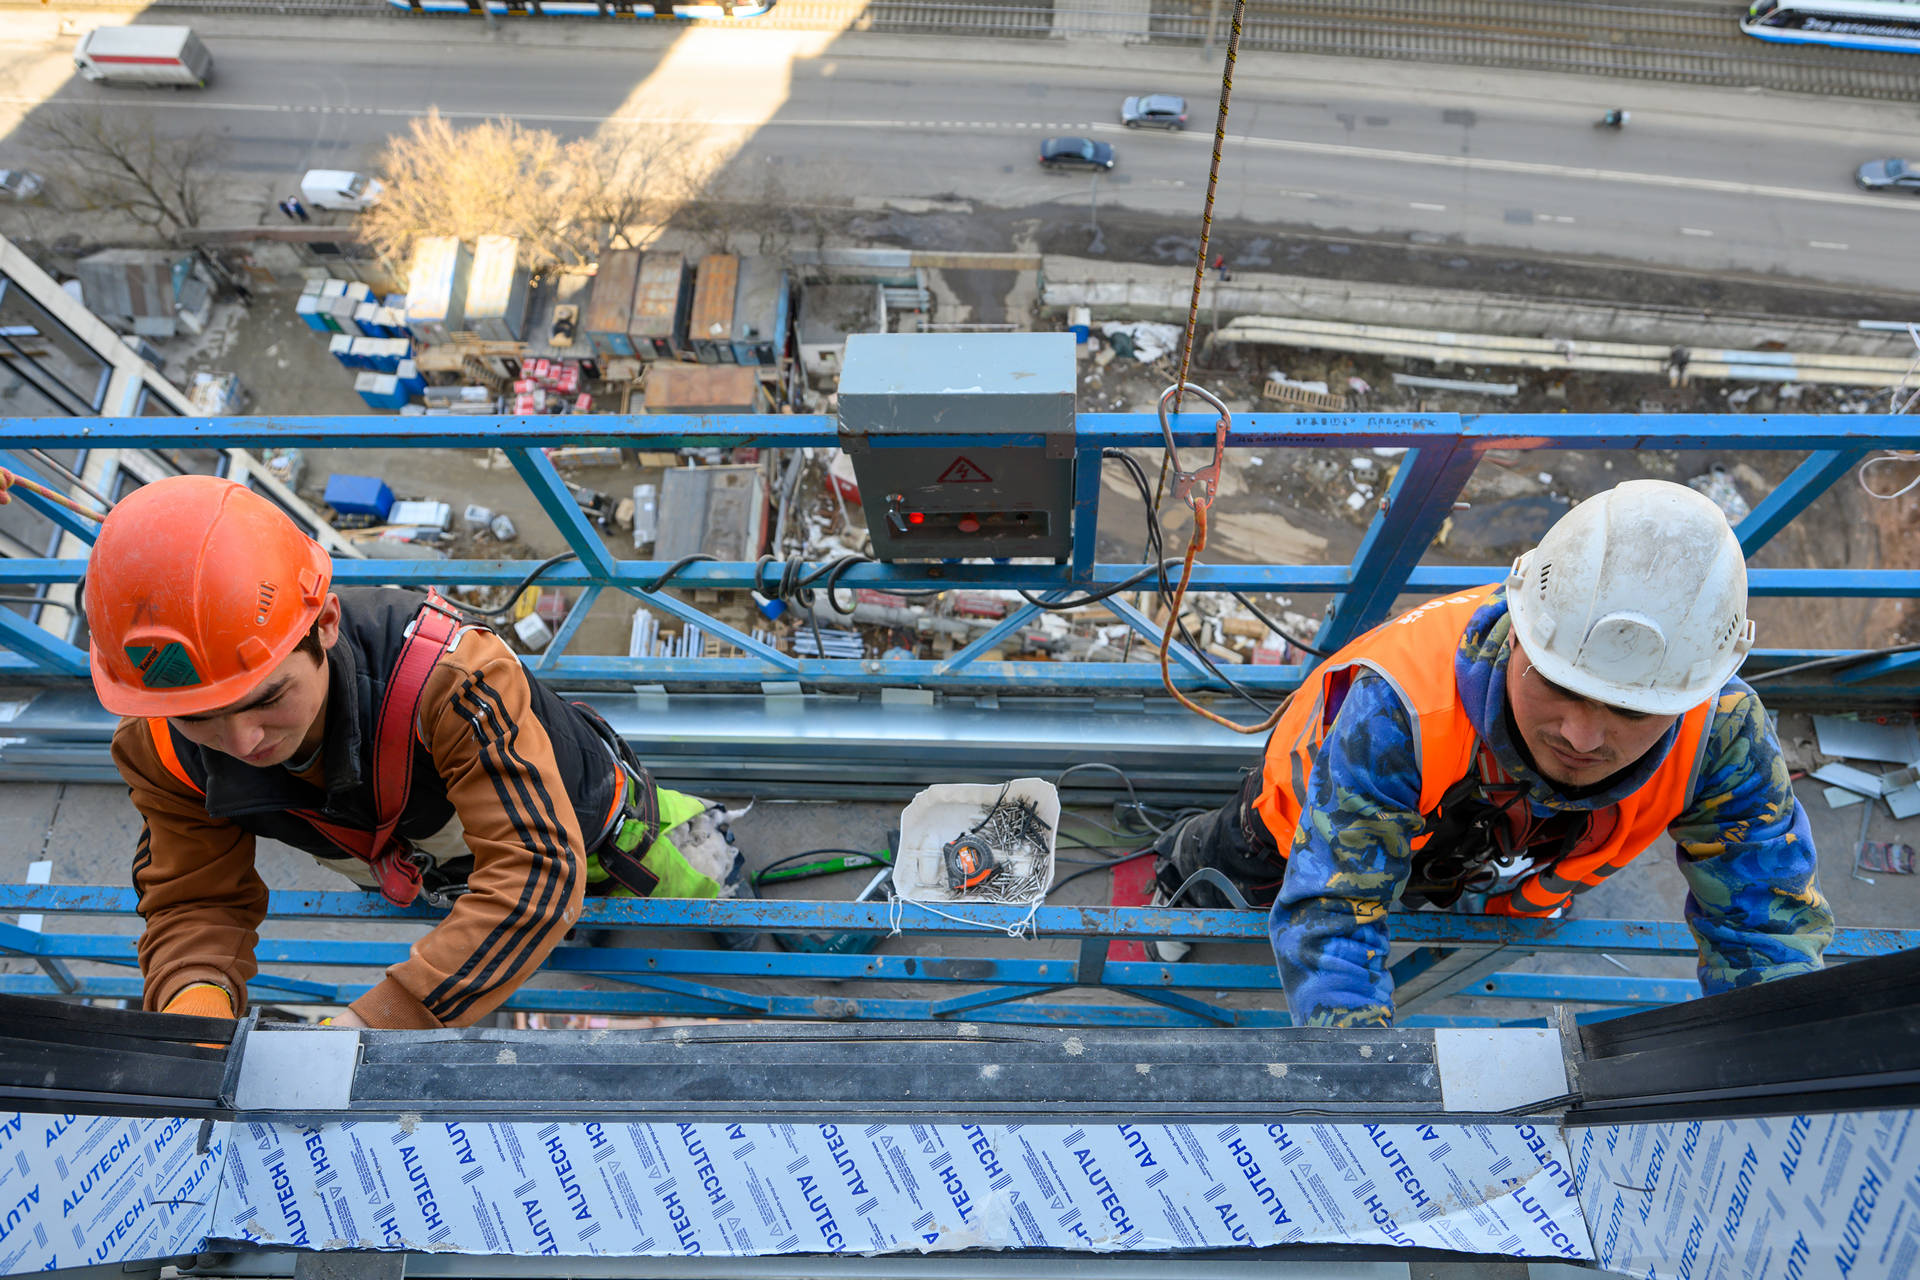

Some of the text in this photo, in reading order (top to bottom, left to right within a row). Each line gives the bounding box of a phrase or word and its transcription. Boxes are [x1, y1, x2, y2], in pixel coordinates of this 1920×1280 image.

[63, 1133, 130, 1218] ALUTECH
[168, 1139, 223, 1215] ALUTECH
[545, 1136, 592, 1220] ALUTECH
[676, 1123, 726, 1205] ALUTECH
[819, 1124, 868, 1195] ALUTEC
[1118, 1124, 1157, 1167] ALUT
[1228, 1138, 1292, 1225] ALUTECH
[1363, 1124, 1430, 1208] ALUTECH
[1515, 1125, 1577, 1199] ALUTEC
[1638, 1140, 1665, 1227] ALUTECH
[269, 1162, 310, 1246] ALUTECH
[399, 1146, 443, 1230] ALUTECH
[662, 1191, 704, 1256] UTECH
[1073, 1148, 1134, 1235] ALUTECH
[1723, 1142, 1759, 1242] ALUTECH
[1834, 1166, 1883, 1280] ALUTECH
[1602, 1191, 1625, 1270] ALUTECH
